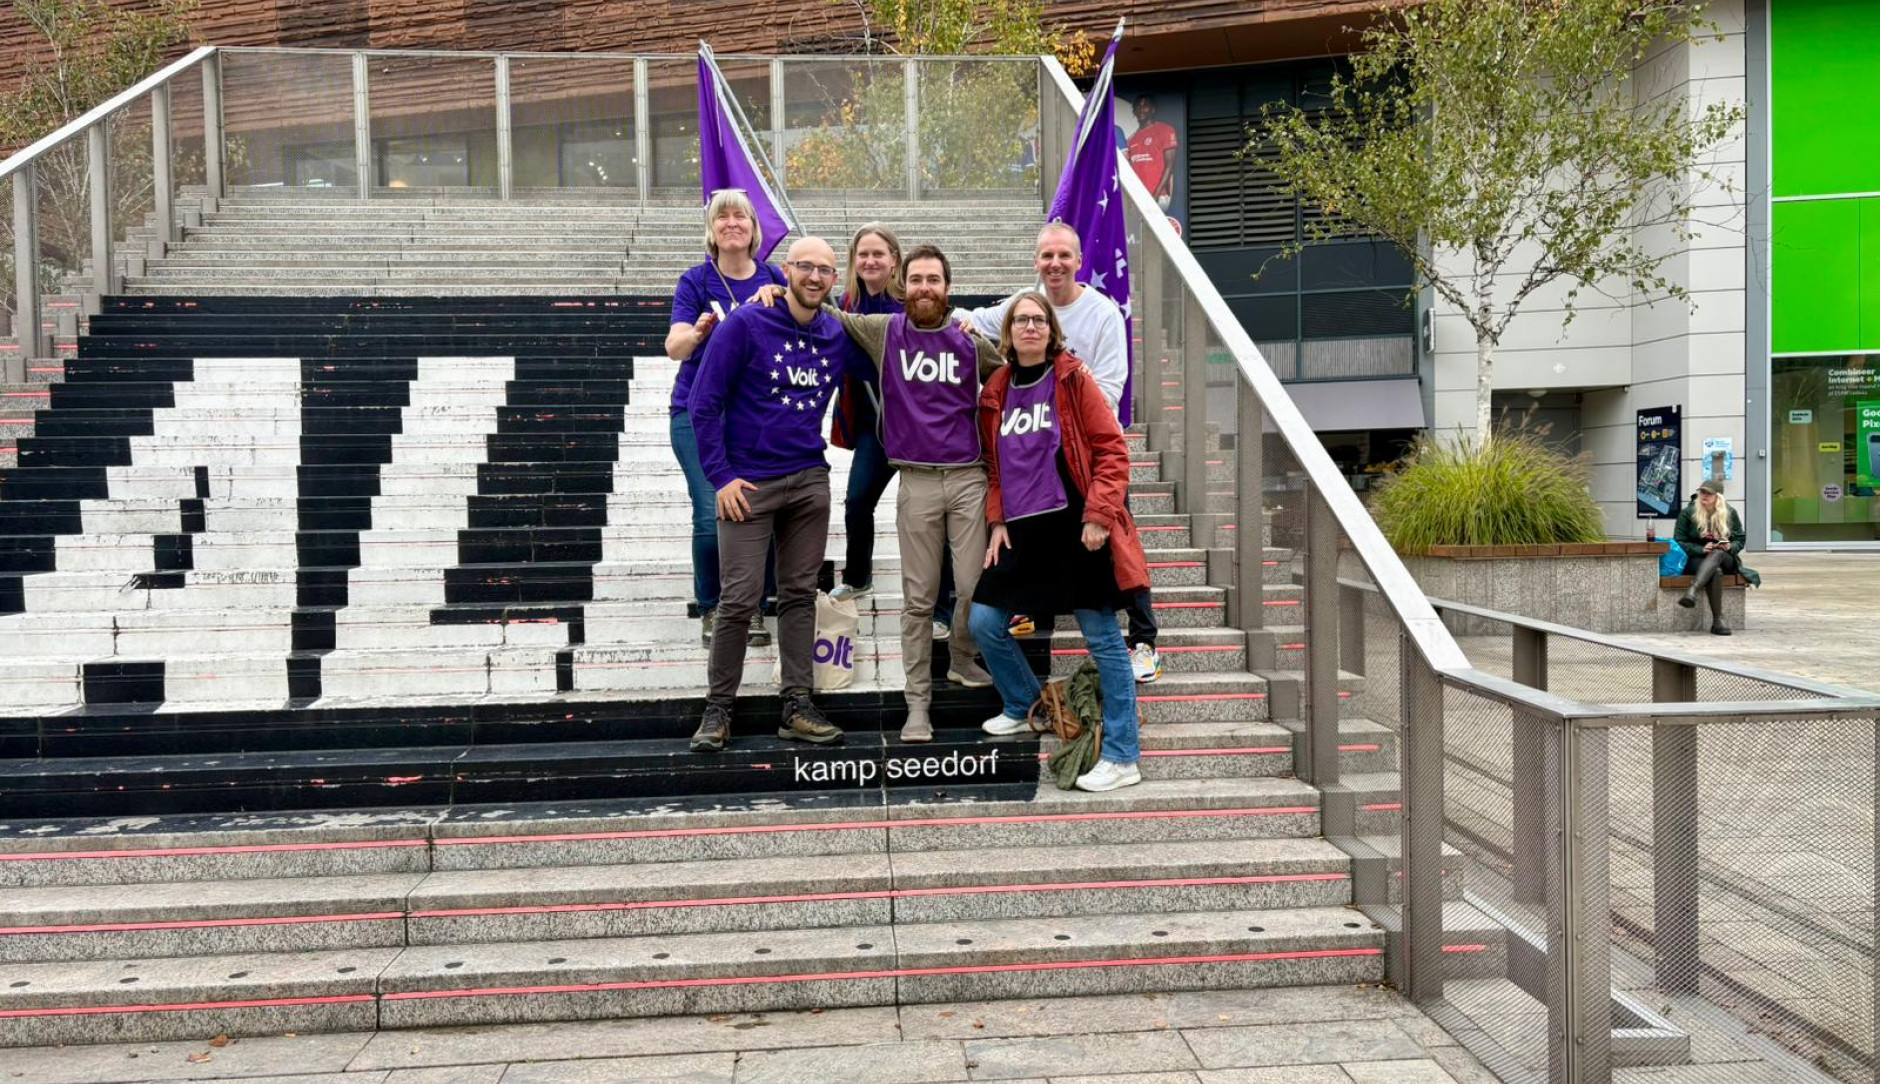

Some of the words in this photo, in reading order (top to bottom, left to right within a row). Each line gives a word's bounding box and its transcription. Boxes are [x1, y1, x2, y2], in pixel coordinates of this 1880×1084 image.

[786, 365, 820, 386] Volt
[900, 349, 961, 384] Volt
[1000, 402, 1052, 437] Volt
[1638, 415, 1662, 427] Forum
[813, 631, 854, 670] olt
[794, 756, 876, 787] kamp
[886, 748, 999, 779] seedorf
